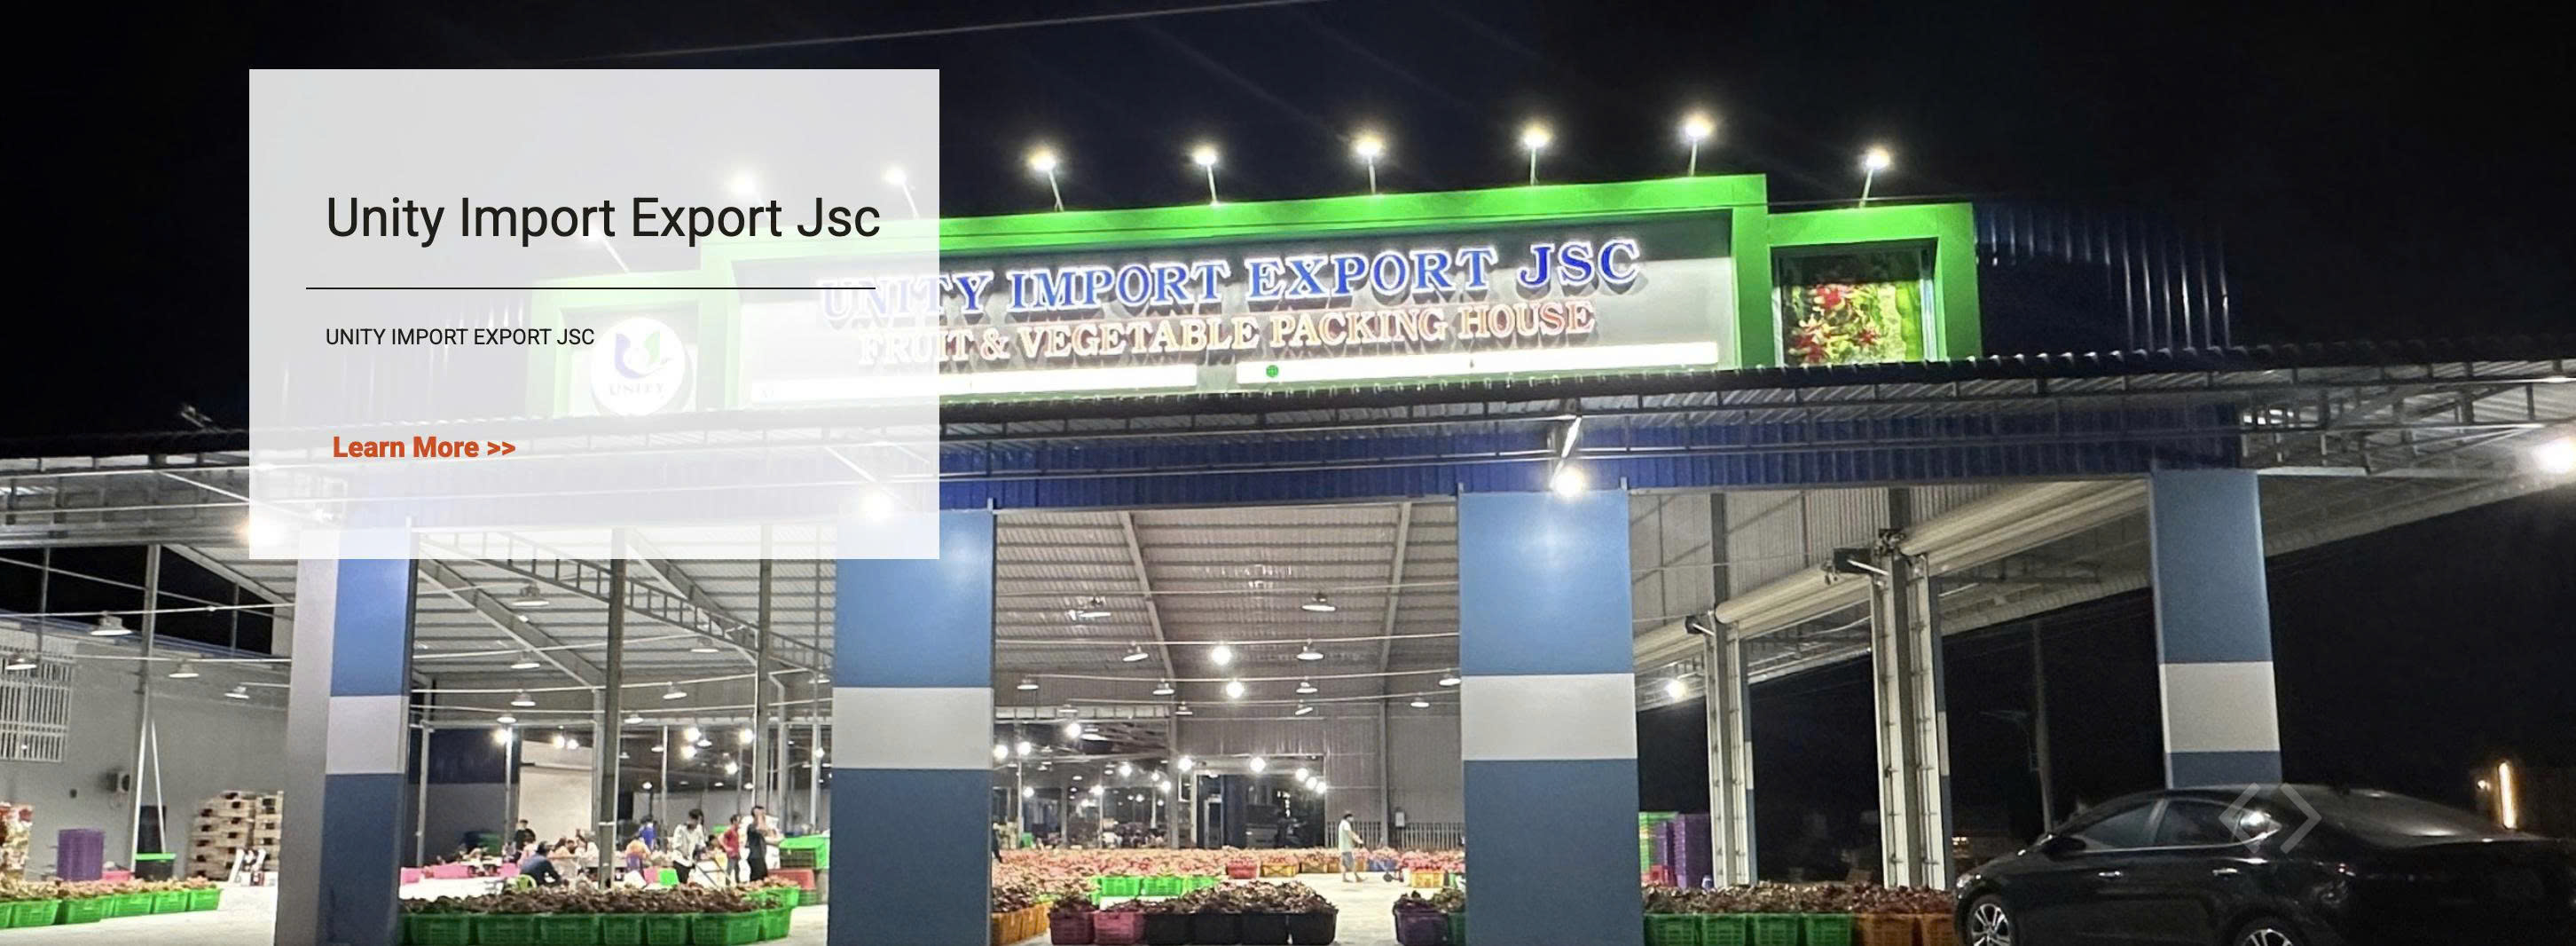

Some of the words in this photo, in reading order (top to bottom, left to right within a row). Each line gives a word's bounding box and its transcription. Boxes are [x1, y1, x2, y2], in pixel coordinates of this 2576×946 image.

[1007, 261, 1230, 312] IMPORT
[1245, 247, 1496, 299] EXPORT
[1518, 238, 1639, 289] JSC
[980, 327, 1010, 360] &
[1017, 315, 1260, 359] VEGETABLE
[1269, 307, 1448, 348] PACKING
[1457, 299, 1596, 339] HOUSE
